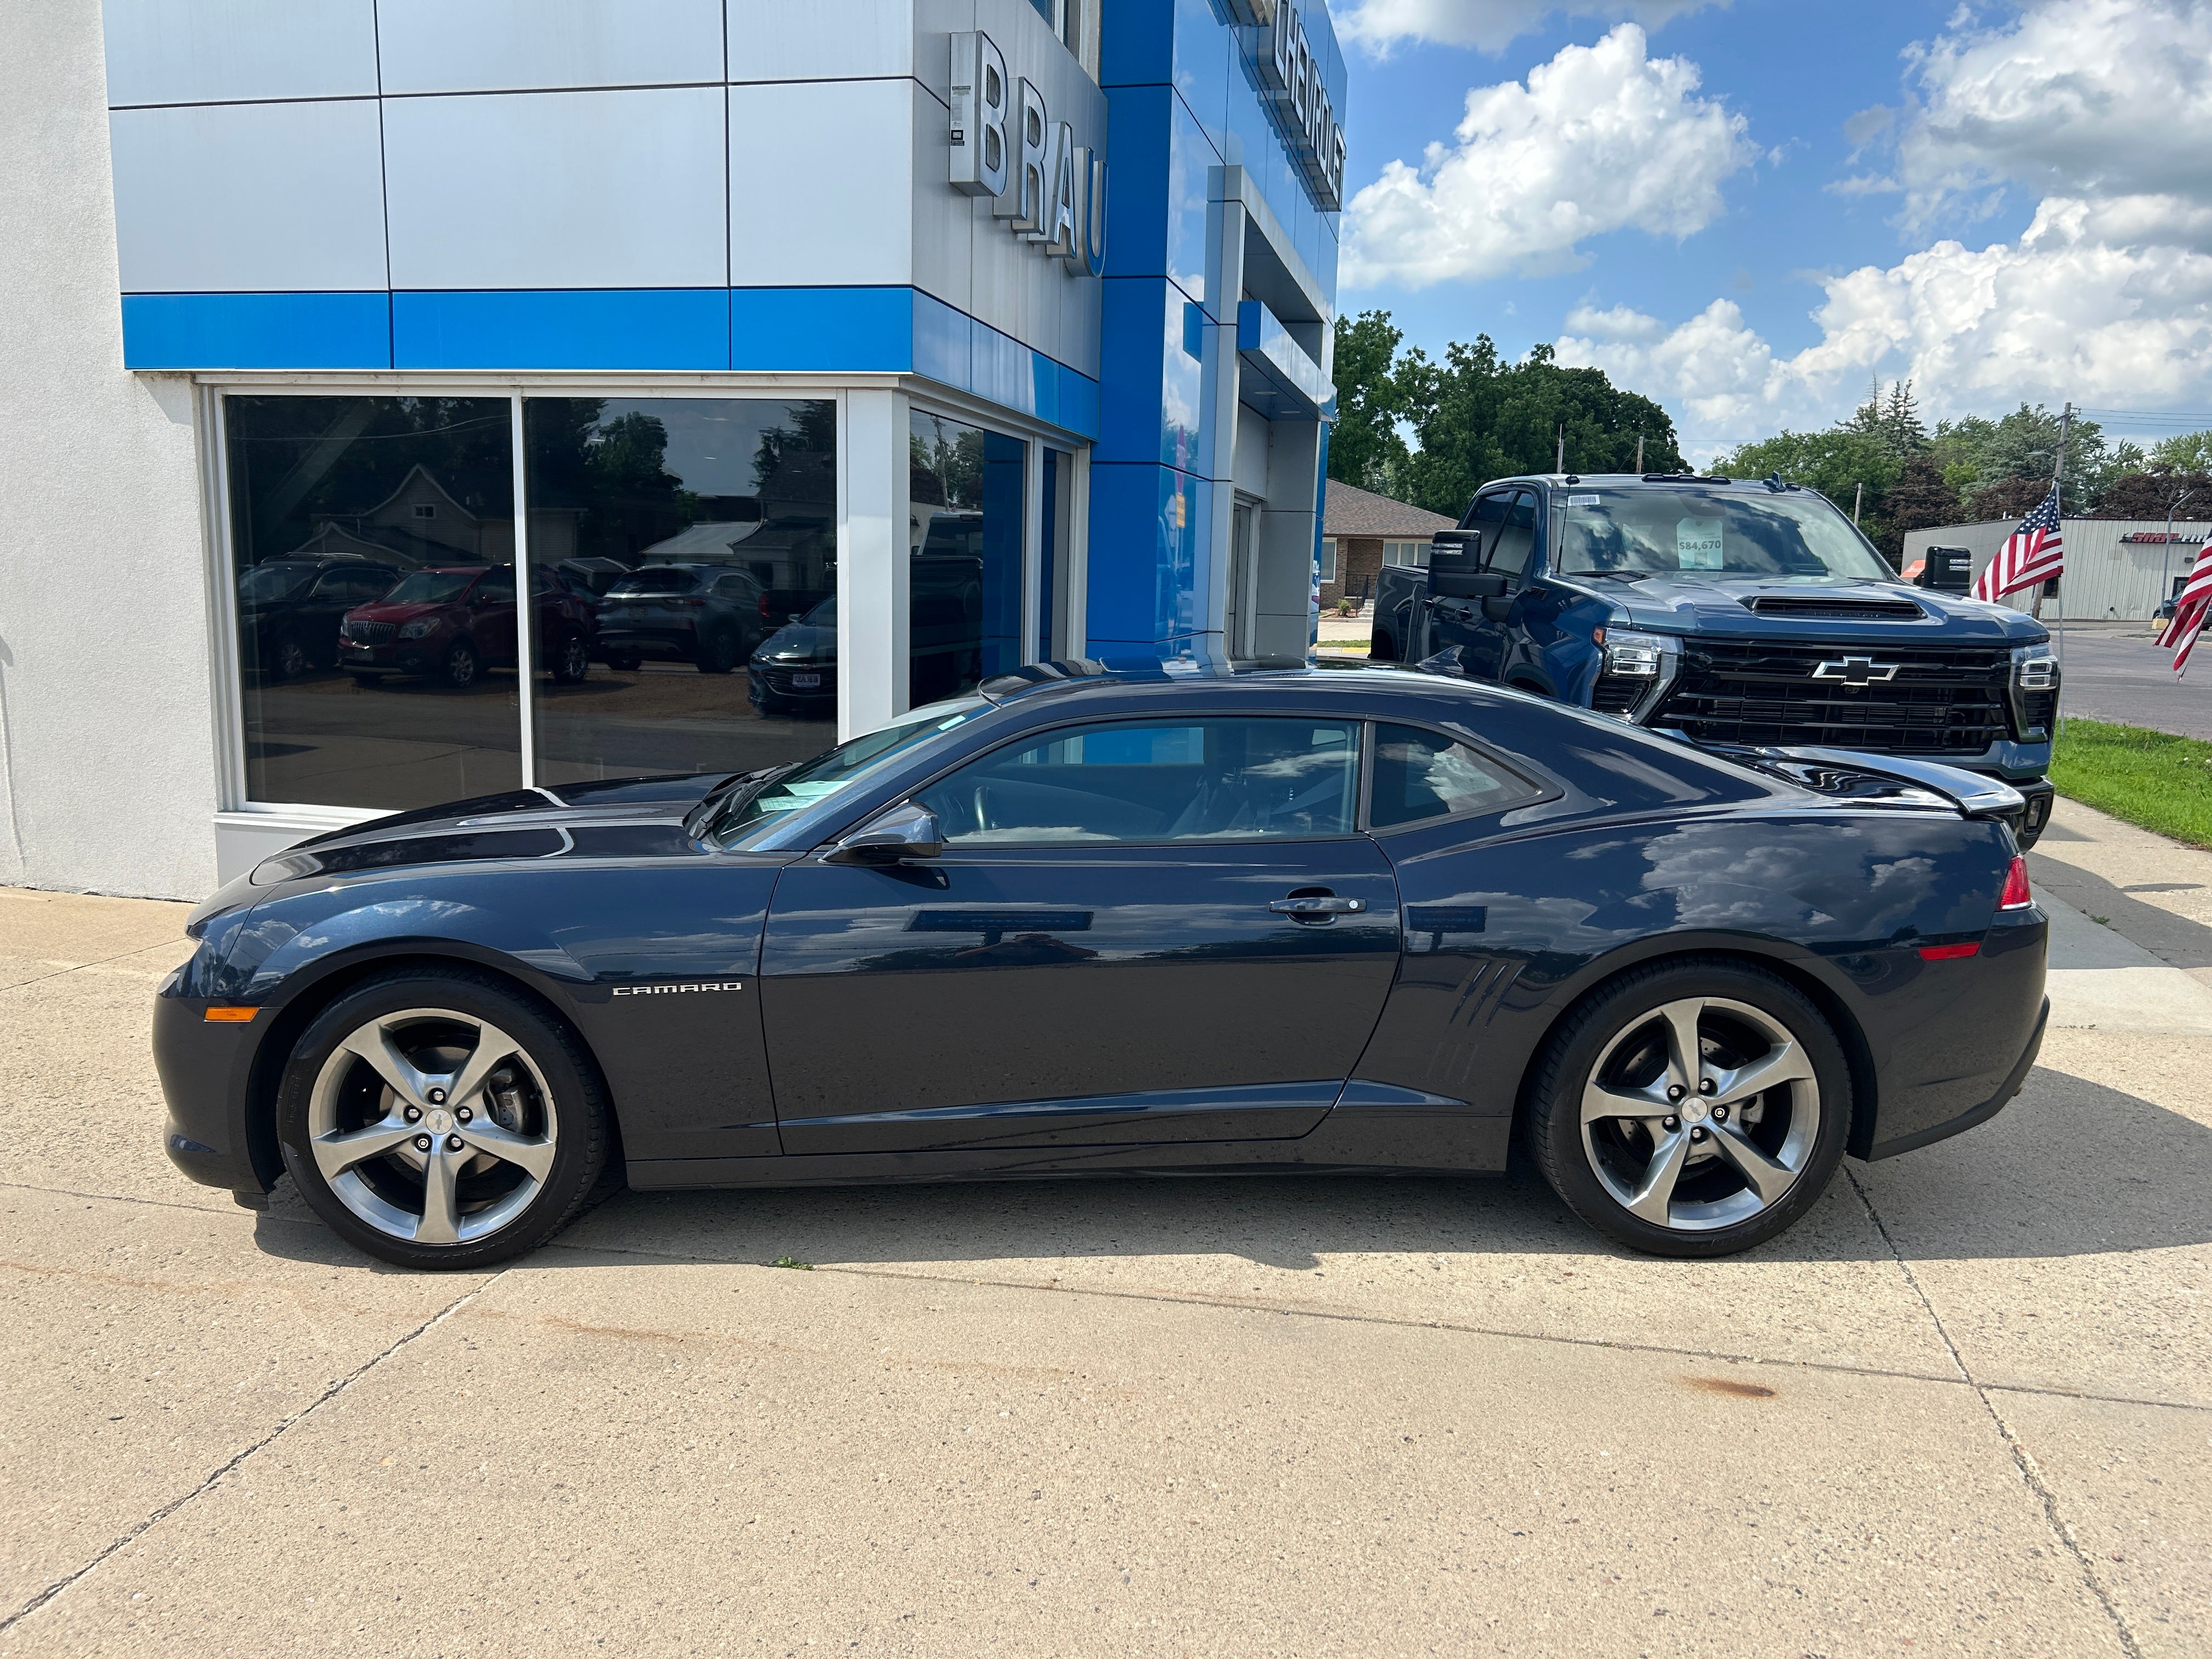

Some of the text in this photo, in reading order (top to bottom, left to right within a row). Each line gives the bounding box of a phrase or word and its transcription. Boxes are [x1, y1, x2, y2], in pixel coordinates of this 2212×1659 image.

[950, 31, 1107, 278] BRAU
[1679, 540, 1721, 551] $84,670
[612, 982, 742, 996] CAMARO
